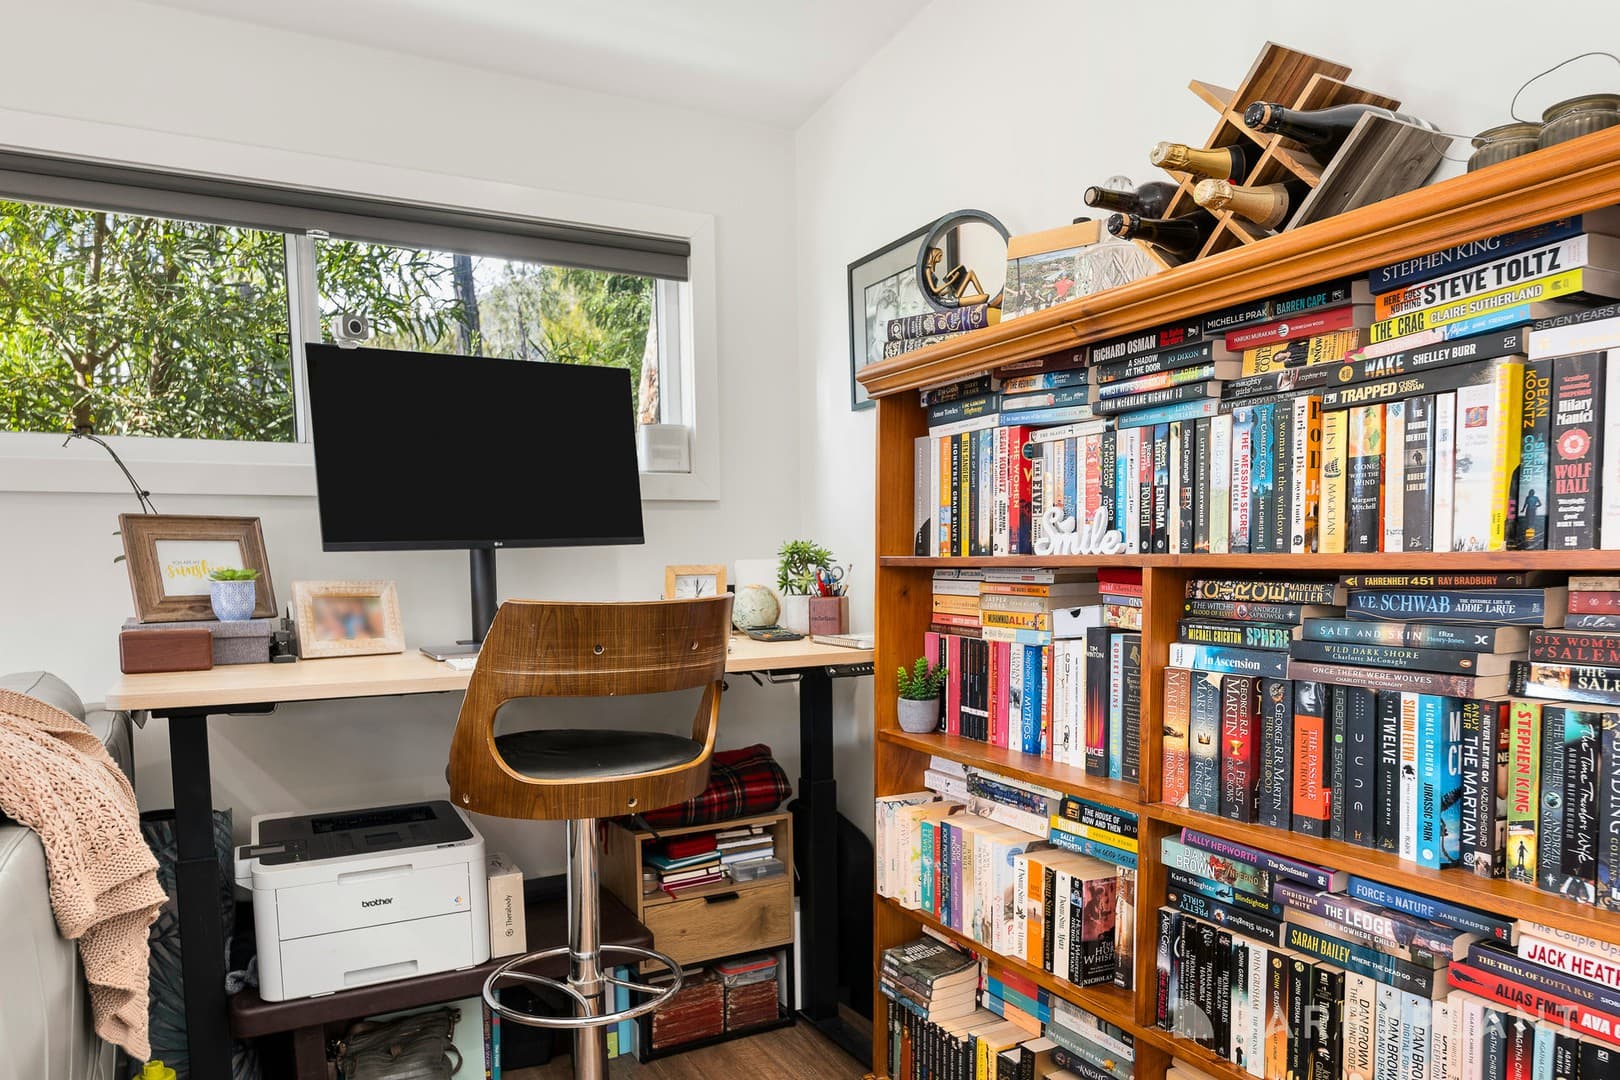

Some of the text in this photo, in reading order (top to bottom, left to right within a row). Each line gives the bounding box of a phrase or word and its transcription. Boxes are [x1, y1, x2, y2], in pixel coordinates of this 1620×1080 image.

[1382, 236, 1501, 282] STEPHEN KING
[1424, 246, 1561, 304] STEVE TOLTZ
[1276, 293, 1326, 314] BARREN CAPE
[1390, 298, 1421, 314] NOTHING
[1431, 284, 1542, 323] CLAIRE SUTHERLAND
[1207, 308, 1267, 329] MICHELLE PRAK
[1375, 312, 1424, 341] THE CRAG
[1535, 307, 1614, 330] SEVEN YEARS
[1094, 335, 1156, 362] RICHARD OSMAN
[1413, 343, 1476, 366] SHELLEY BURR
[1133, 367, 1144, 375] THE
[1146, 363, 1160, 373] DOOR
[1365, 354, 1404, 377] WAKE
[1341, 382, 1397, 403] TRAPPED
[1524, 370, 1537, 428] KOONTZ
[1536, 377, 1549, 417] DEAN
[1559, 398, 1592, 413] Hilary
[1557, 410, 1592, 425] Mantel
[1279, 463, 1288, 472] in
[1523, 435, 1534, 482] CORNER
[1535, 441, 1545, 480] SILENT
[1555, 463, 1591, 479] WOLF
[1240, 454, 1249, 499] MESSIAH
[1278, 476, 1287, 491] the
[1556, 480, 1589, 494] HALL
[1156, 488, 1164, 529] ENIGMA
[1240, 503, 1248, 539] SECRET
[1276, 496, 1287, 535] window
[1034, 505, 1127, 556] Smile
[1203, 581, 1285, 600] CIRCE
[1289, 583, 1325, 593] MADELINE
[1364, 577, 1434, 586] FAHRENHEIT 451
[1438, 576, 1498, 585] RAY BRADBURY
[1288, 591, 1323, 602] MILLER
[1358, 594, 1450, 614] V.E. SCHWAB
[1008, 616, 1025, 625] ALI
[1320, 626, 1423, 641] SALT AND SKIN
[1188, 628, 1212, 642] MICHAEL
[1213, 630, 1242, 644] CRICHTON
[1246, 627, 1290, 649] SPHERE
[1535, 635, 1561, 645] SIX
[1024, 649, 1033, 679] Stephen
[1204, 656, 1260, 671] In Ascension
[1324, 645, 1419, 659] WILD DARK SHORE
[1024, 681, 1032, 692] Fry
[1313, 667, 1432, 684] ONCE THERE WERE WOLVES
[1226, 678, 1239, 736] MARTIN
[1463, 703, 1471, 729] WEIR
[1265, 716, 1273, 739] FIRE
[1424, 703, 1434, 776] MICHAEL CRICHTON
[1481, 715, 1490, 782] NEVER LET ME GO
[1517, 711, 1532, 775] STEPHEN
[1553, 714, 1563, 788] THE WITCHER
[1265, 759, 1273, 793] BLOOD
[1308, 729, 1318, 800] THE PASSAGE
[1195, 761, 1203, 796] KINGS
[1463, 736, 1478, 845] THE MARTIAN
[1514, 778, 1529, 813] KING
[1082, 816, 1121, 833] NOW AND THEN
[1095, 811, 1111, 821] HOUSE
[1113, 815, 1120, 824] OF
[1424, 782, 1433, 842] JURASSIC PARK
[1480, 812, 1488, 847] ISHIGURO
[1542, 811, 1551, 868] SAPKOWSKI
[1187, 834, 1257, 863] SALLY HEPWORTH
[1176, 855, 1215, 878] BROWN
[1267, 859, 1309, 879] The Soulmate
[1171, 873, 1215, 893] Karin Slaughter
[362, 897, 393, 908] brother
[1282, 889, 1318, 905] CHRISTIAN
[1324, 904, 1393, 939] THE LEDGE
[1438, 911, 1490, 933] JANE HARPER
[1160, 914, 1170, 956] Alex Gray
[1291, 929, 1350, 964] SARAH BAILEY
[1351, 955, 1411, 981] WHERE THE DEAD GO
[1528, 944, 1567, 970] JACK
[1252, 949, 1261, 1010] JOHN GRISHAM
[1495, 983, 1533, 1007] ALIAS
[1536, 1000, 1578, 1023] EMMA
[1358, 999, 1369, 1070] DAN BROWN
[1388, 1017, 1399, 1043] DAN
[1581, 1013, 1611, 1036] AVA
[1402, 1023, 1410, 1053] DIGITAL
[1411, 1026, 1425, 1052] DAN
